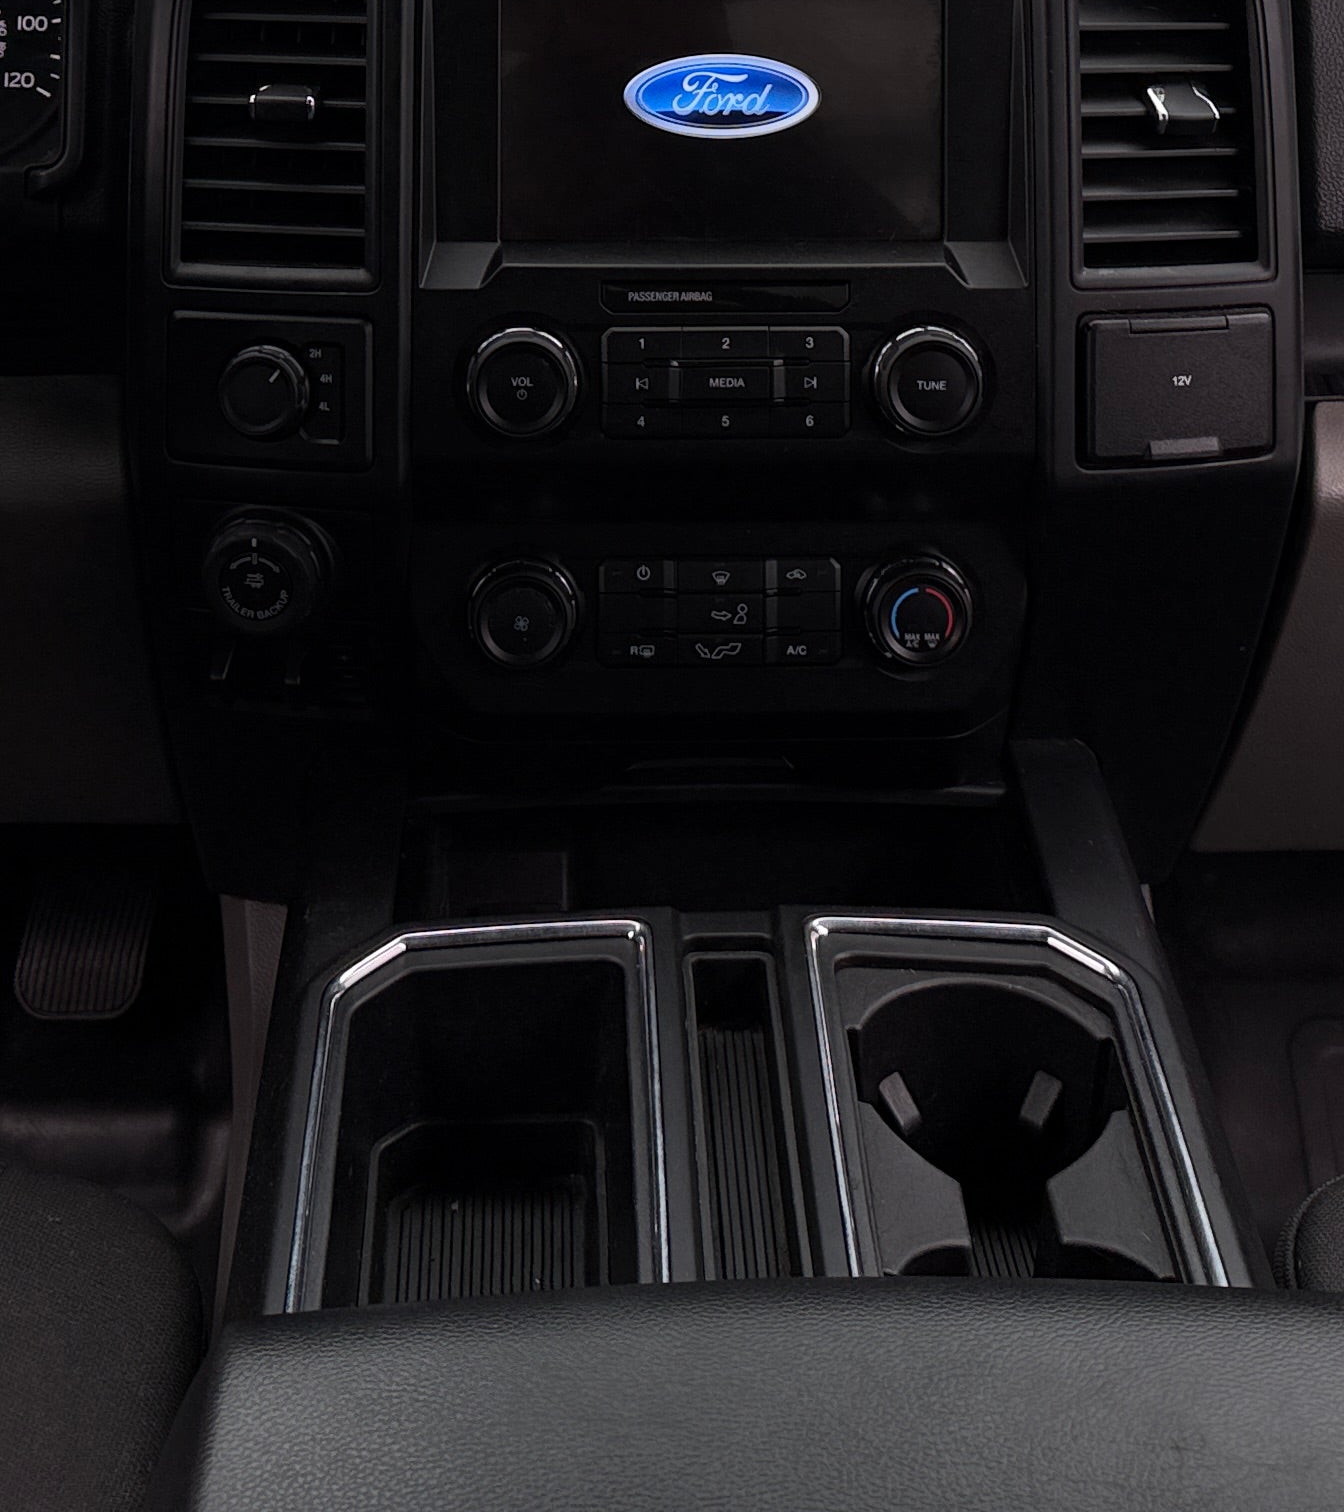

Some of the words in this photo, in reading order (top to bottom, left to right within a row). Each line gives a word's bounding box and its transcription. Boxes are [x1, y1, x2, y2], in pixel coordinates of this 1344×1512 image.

[17, 15, 48, 32] 100
[4, 72, 35, 88] 120
[672, 70, 773, 116] Ford
[628, 291, 679, 303] PASSENGER
[680, 291, 713, 302] AIRBAG
[638, 337, 645, 350] 1
[721, 337, 730, 350] 2
[805, 336, 815, 349] 3
[309, 348, 322, 359] 2H
[319, 373, 333, 384] 4H
[511, 376, 534, 387] VOL
[709, 377, 745, 388] MEDIA
[1172, 374, 1192, 386] 12V
[916, 380, 947, 391] TUNE
[318, 401, 330, 412] 4L
[636, 415, 646, 427] 4
[721, 415, 730, 427] 5
[805, 414, 815, 427] 6
[222, 586, 254, 619] TRAILER
[256, 589, 289, 619] BACKUP
[904, 634, 921, 642] MAX
[924, 634, 940, 642] MAX
[630, 645, 639, 656] R
[786, 645, 807, 656] A/C
